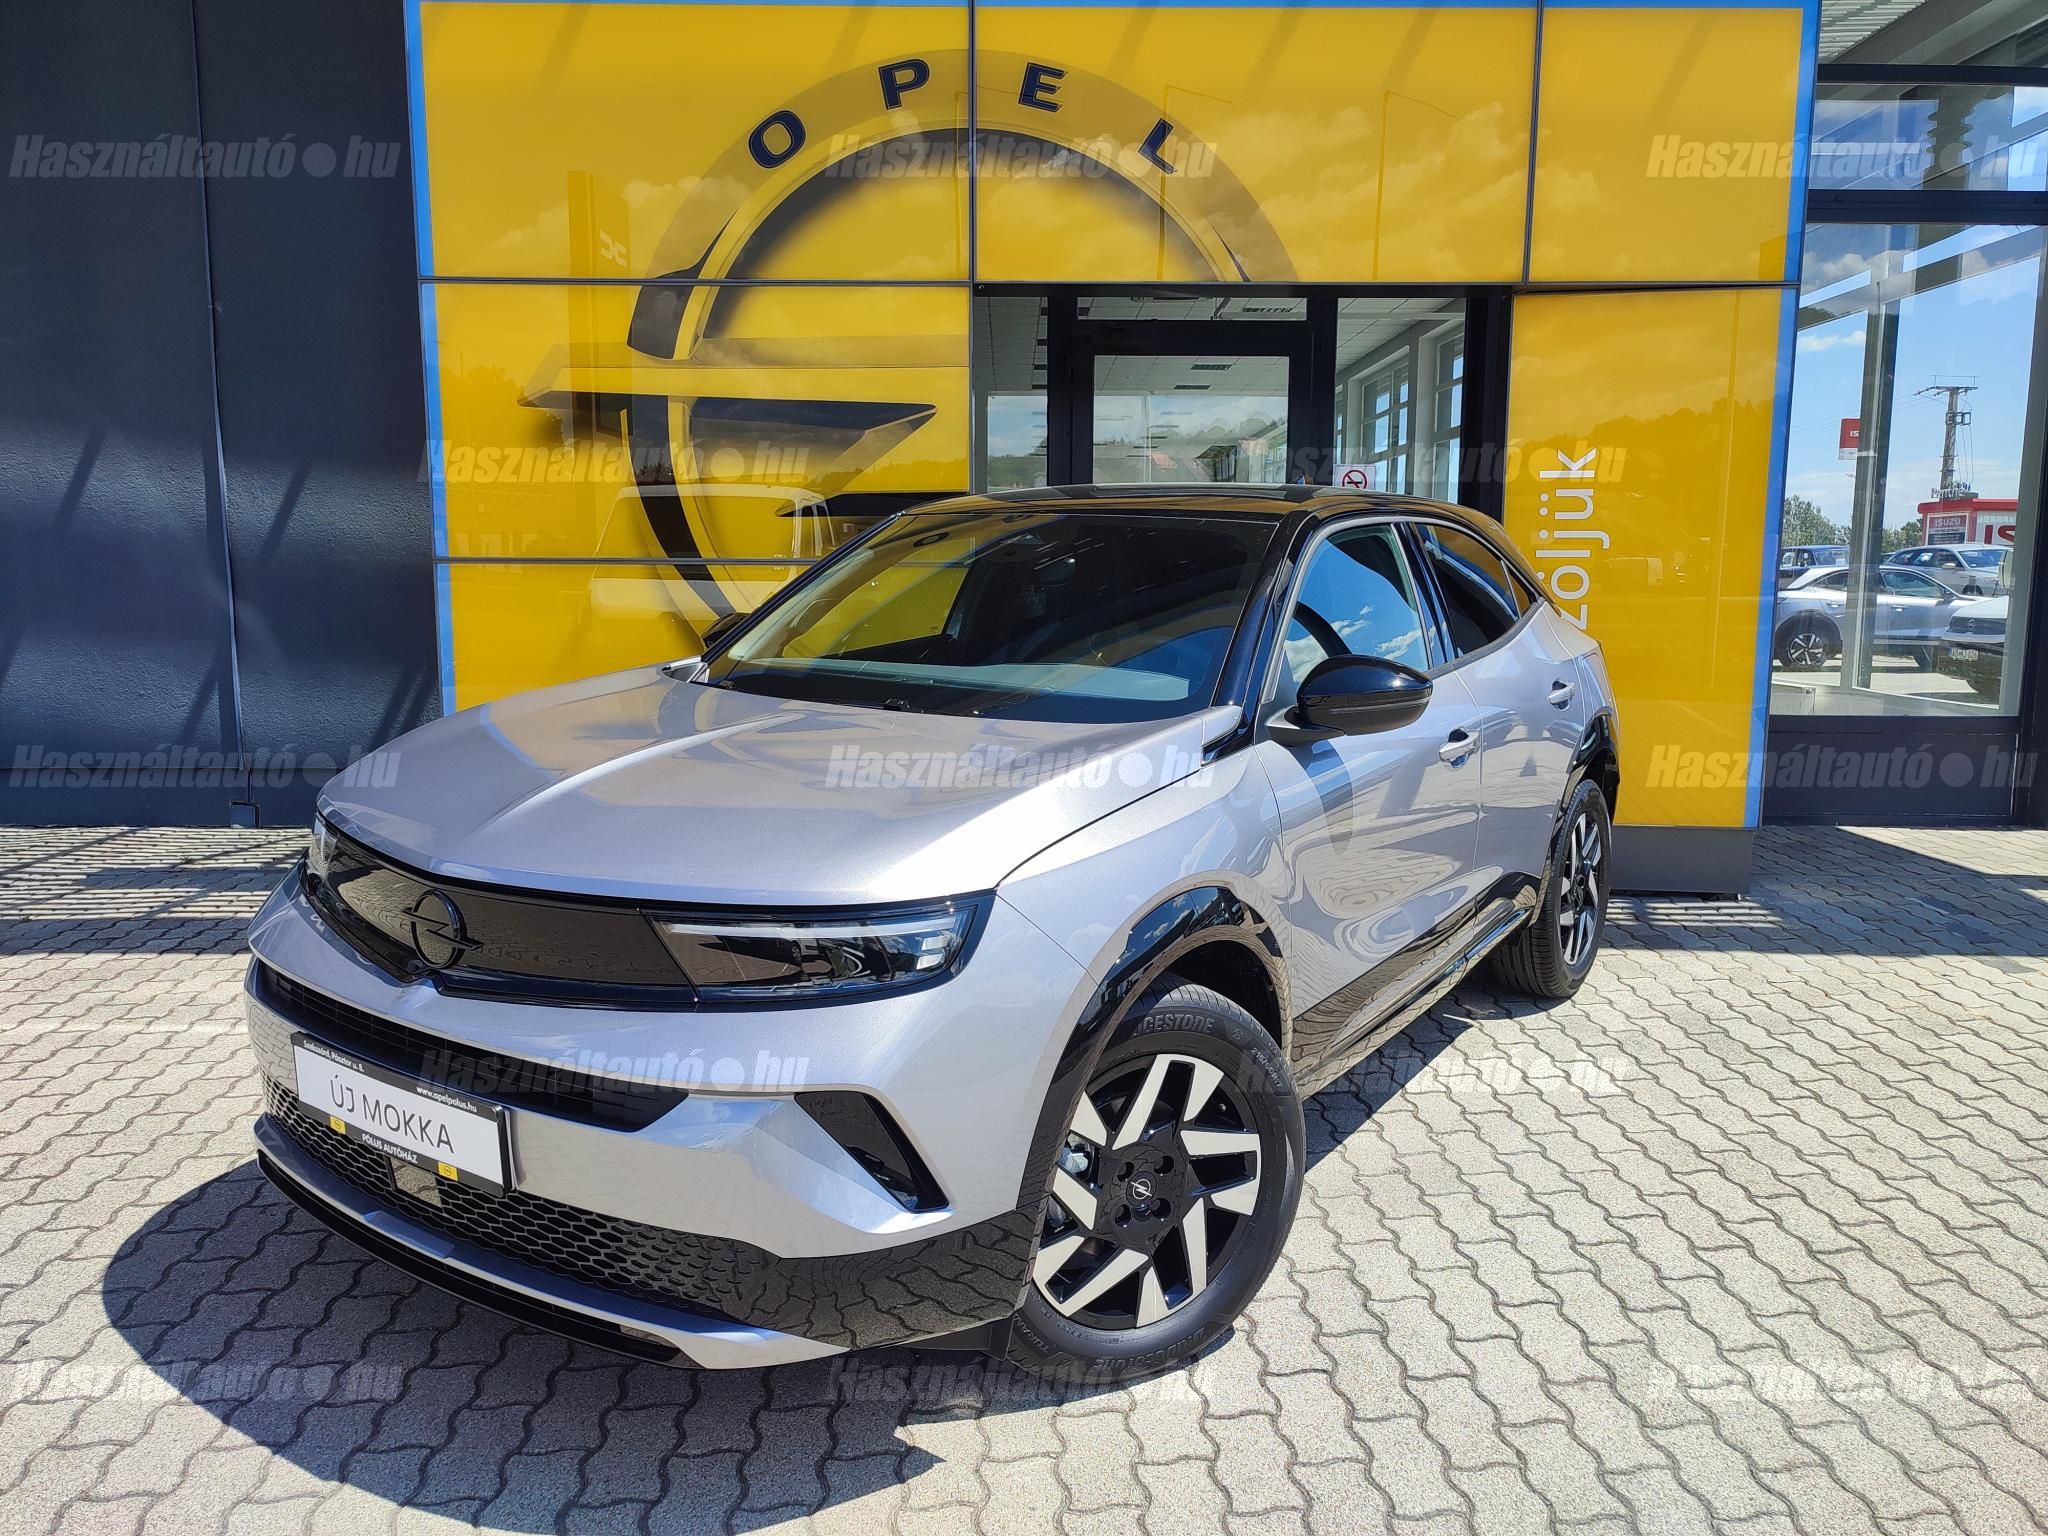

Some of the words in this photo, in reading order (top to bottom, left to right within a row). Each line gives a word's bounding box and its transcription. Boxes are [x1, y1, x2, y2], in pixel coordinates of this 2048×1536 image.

[748, 58, 1178, 175] OPEL
[1935, 517, 1961, 527] ISUZU
[1131, 1013, 1216, 1036] GESTONE
[330, 1074, 355, 1113] ÚJ
[362, 1093, 454, 1154] MOKKA
[416, 1086, 477, 1113] www.opelpolus.hu
[361, 1133, 383, 1150] PÓLUS
[384, 1144, 418, 1164] AUTÓHÁZ
